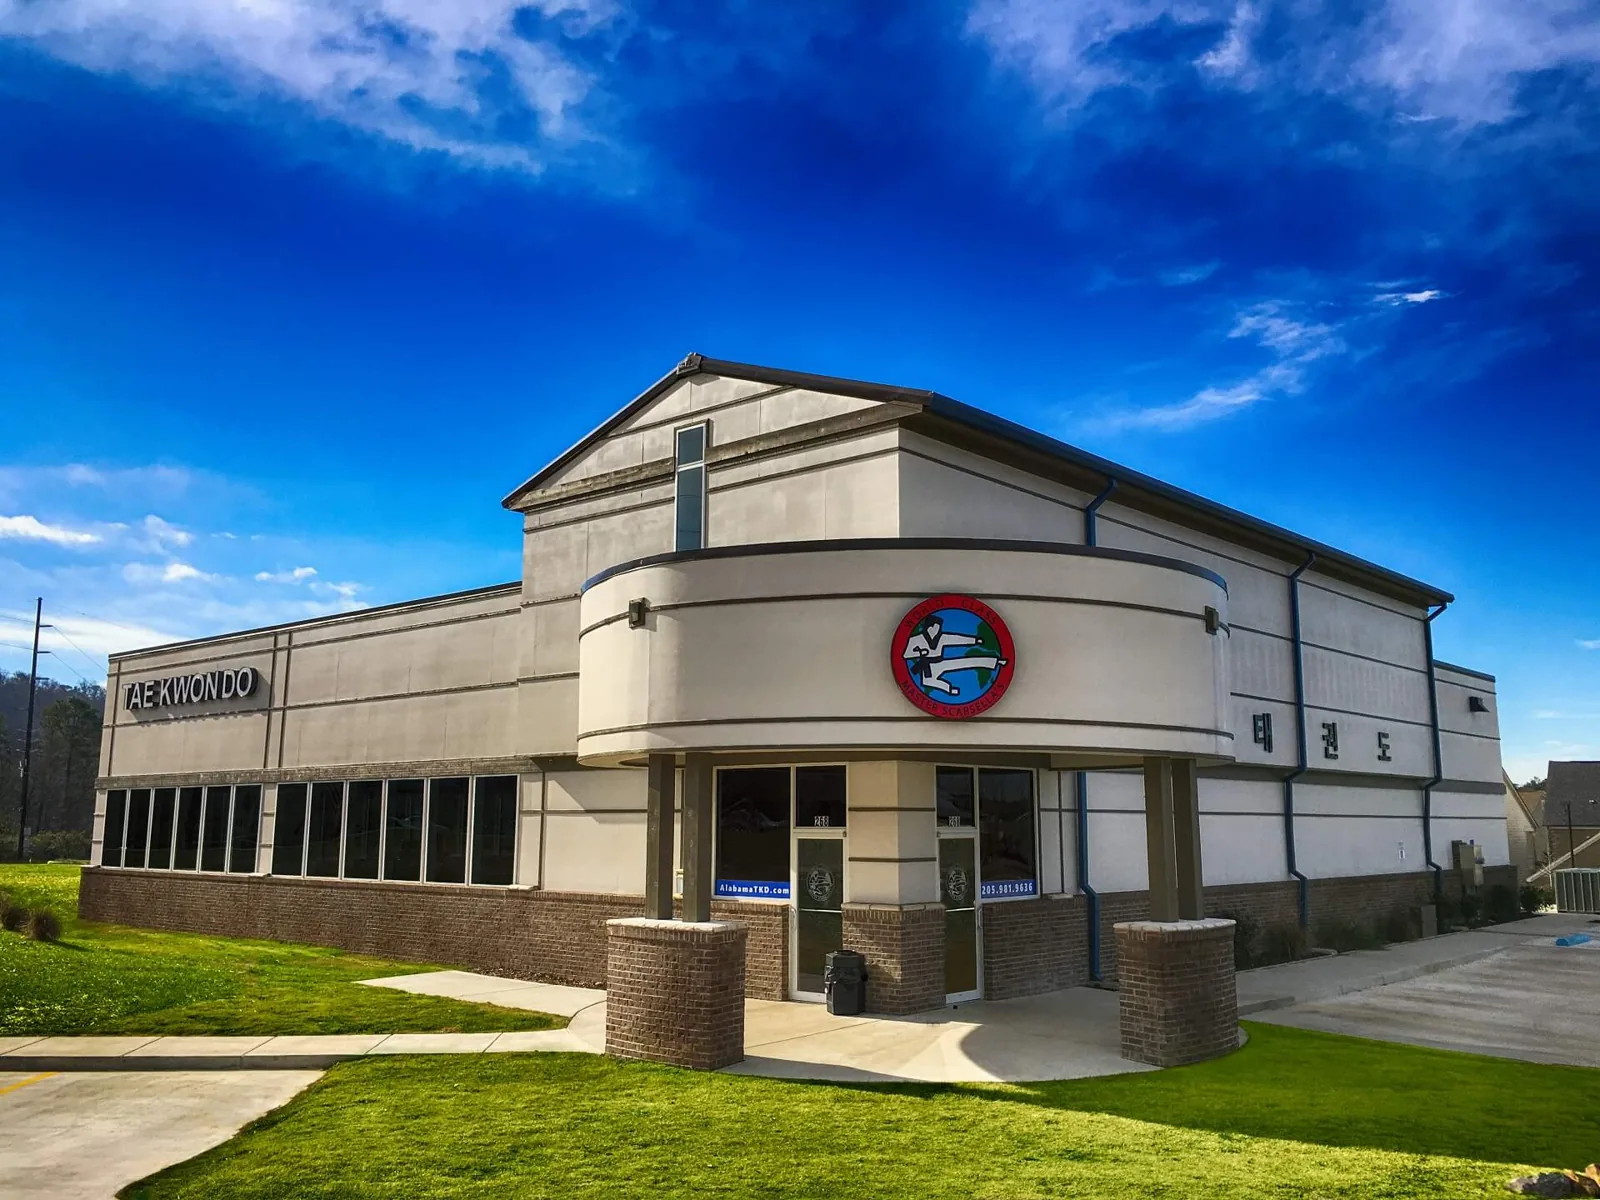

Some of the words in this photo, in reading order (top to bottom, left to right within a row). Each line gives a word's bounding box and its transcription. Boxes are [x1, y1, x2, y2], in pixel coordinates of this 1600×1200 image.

[961, 599, 998, 625] CLASS
[122, 680, 156, 710] TAE
[900, 680, 938, 712] MASTER
[814, 815, 829, 828] 268
[719, 884, 790, 895] AlabamaTKD.com
[981, 882, 1033, 895] 205.981.9636
